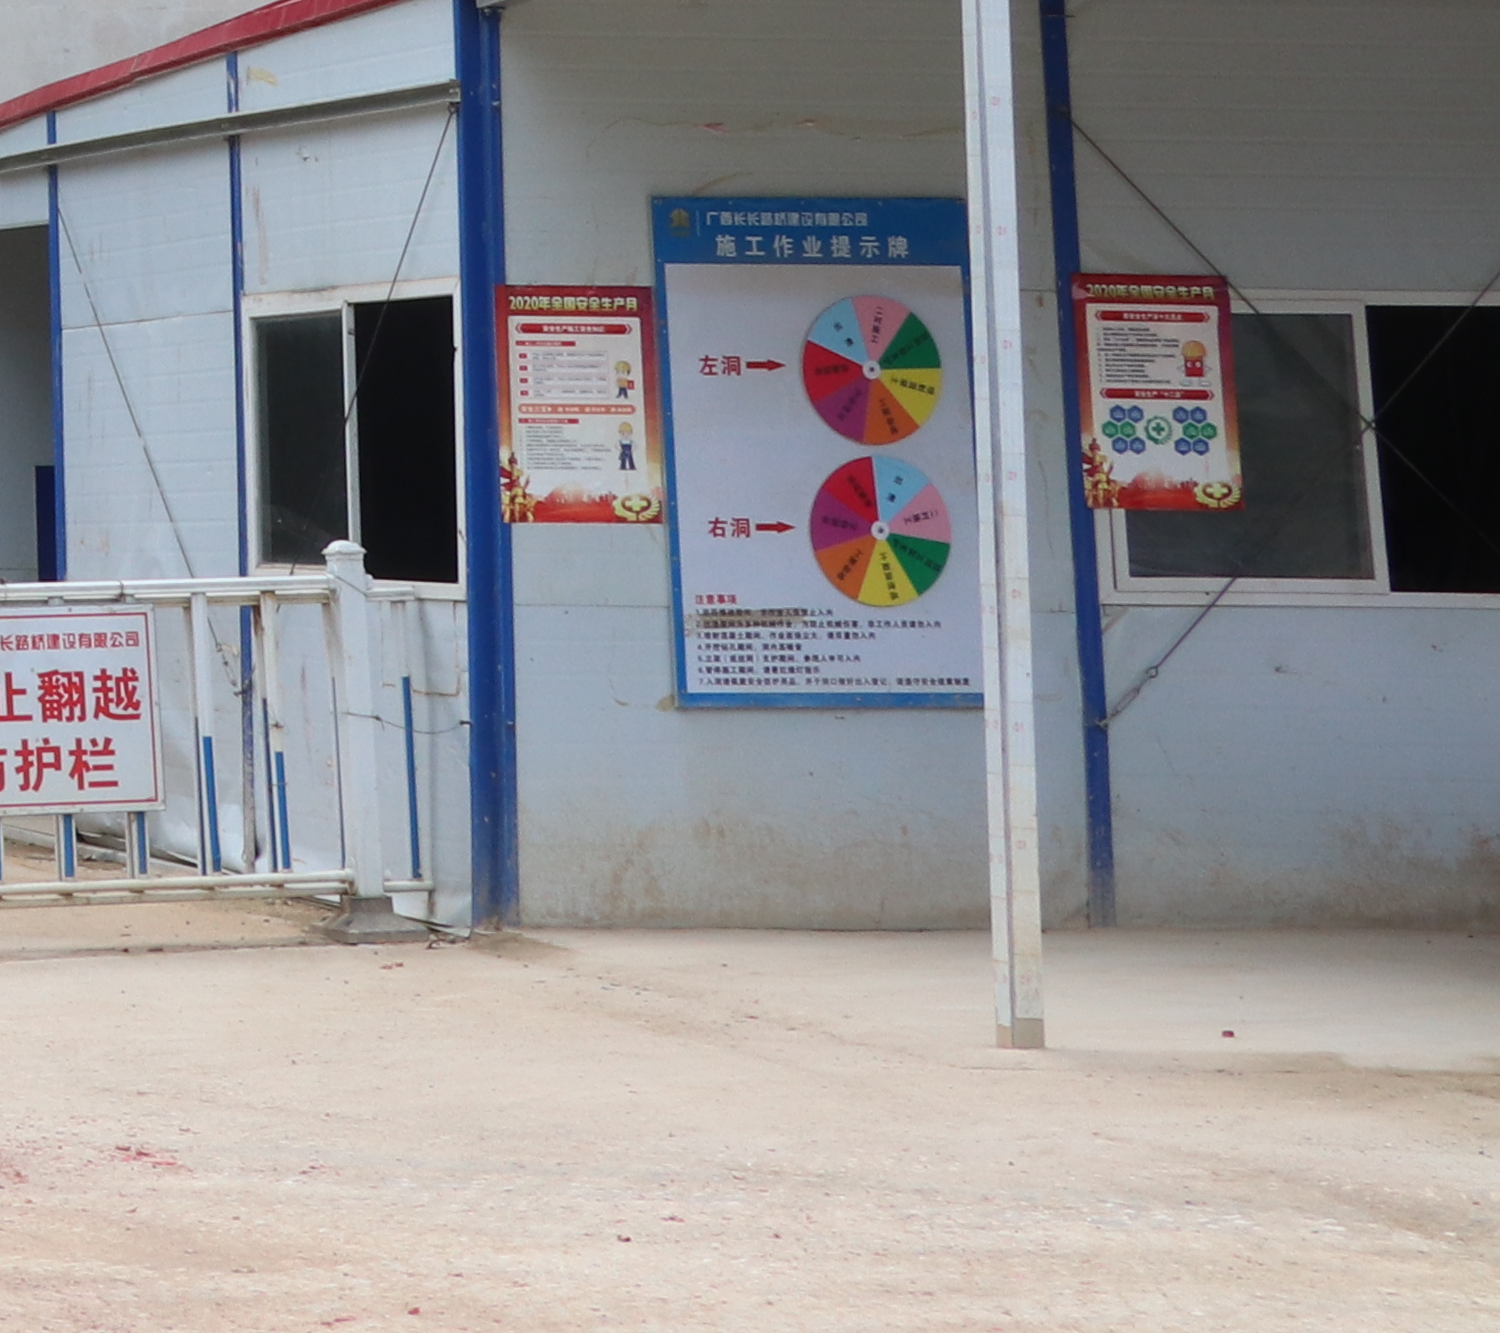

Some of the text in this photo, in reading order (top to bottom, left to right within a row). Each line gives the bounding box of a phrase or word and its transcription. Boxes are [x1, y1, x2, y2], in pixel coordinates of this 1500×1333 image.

[715, 234, 910, 259] 施工作业提示牌
[508, 296, 638, 311] 2020年全国安全生产月
[699, 354, 742, 378] 左洞
[708, 516, 752, 540] 右洞
